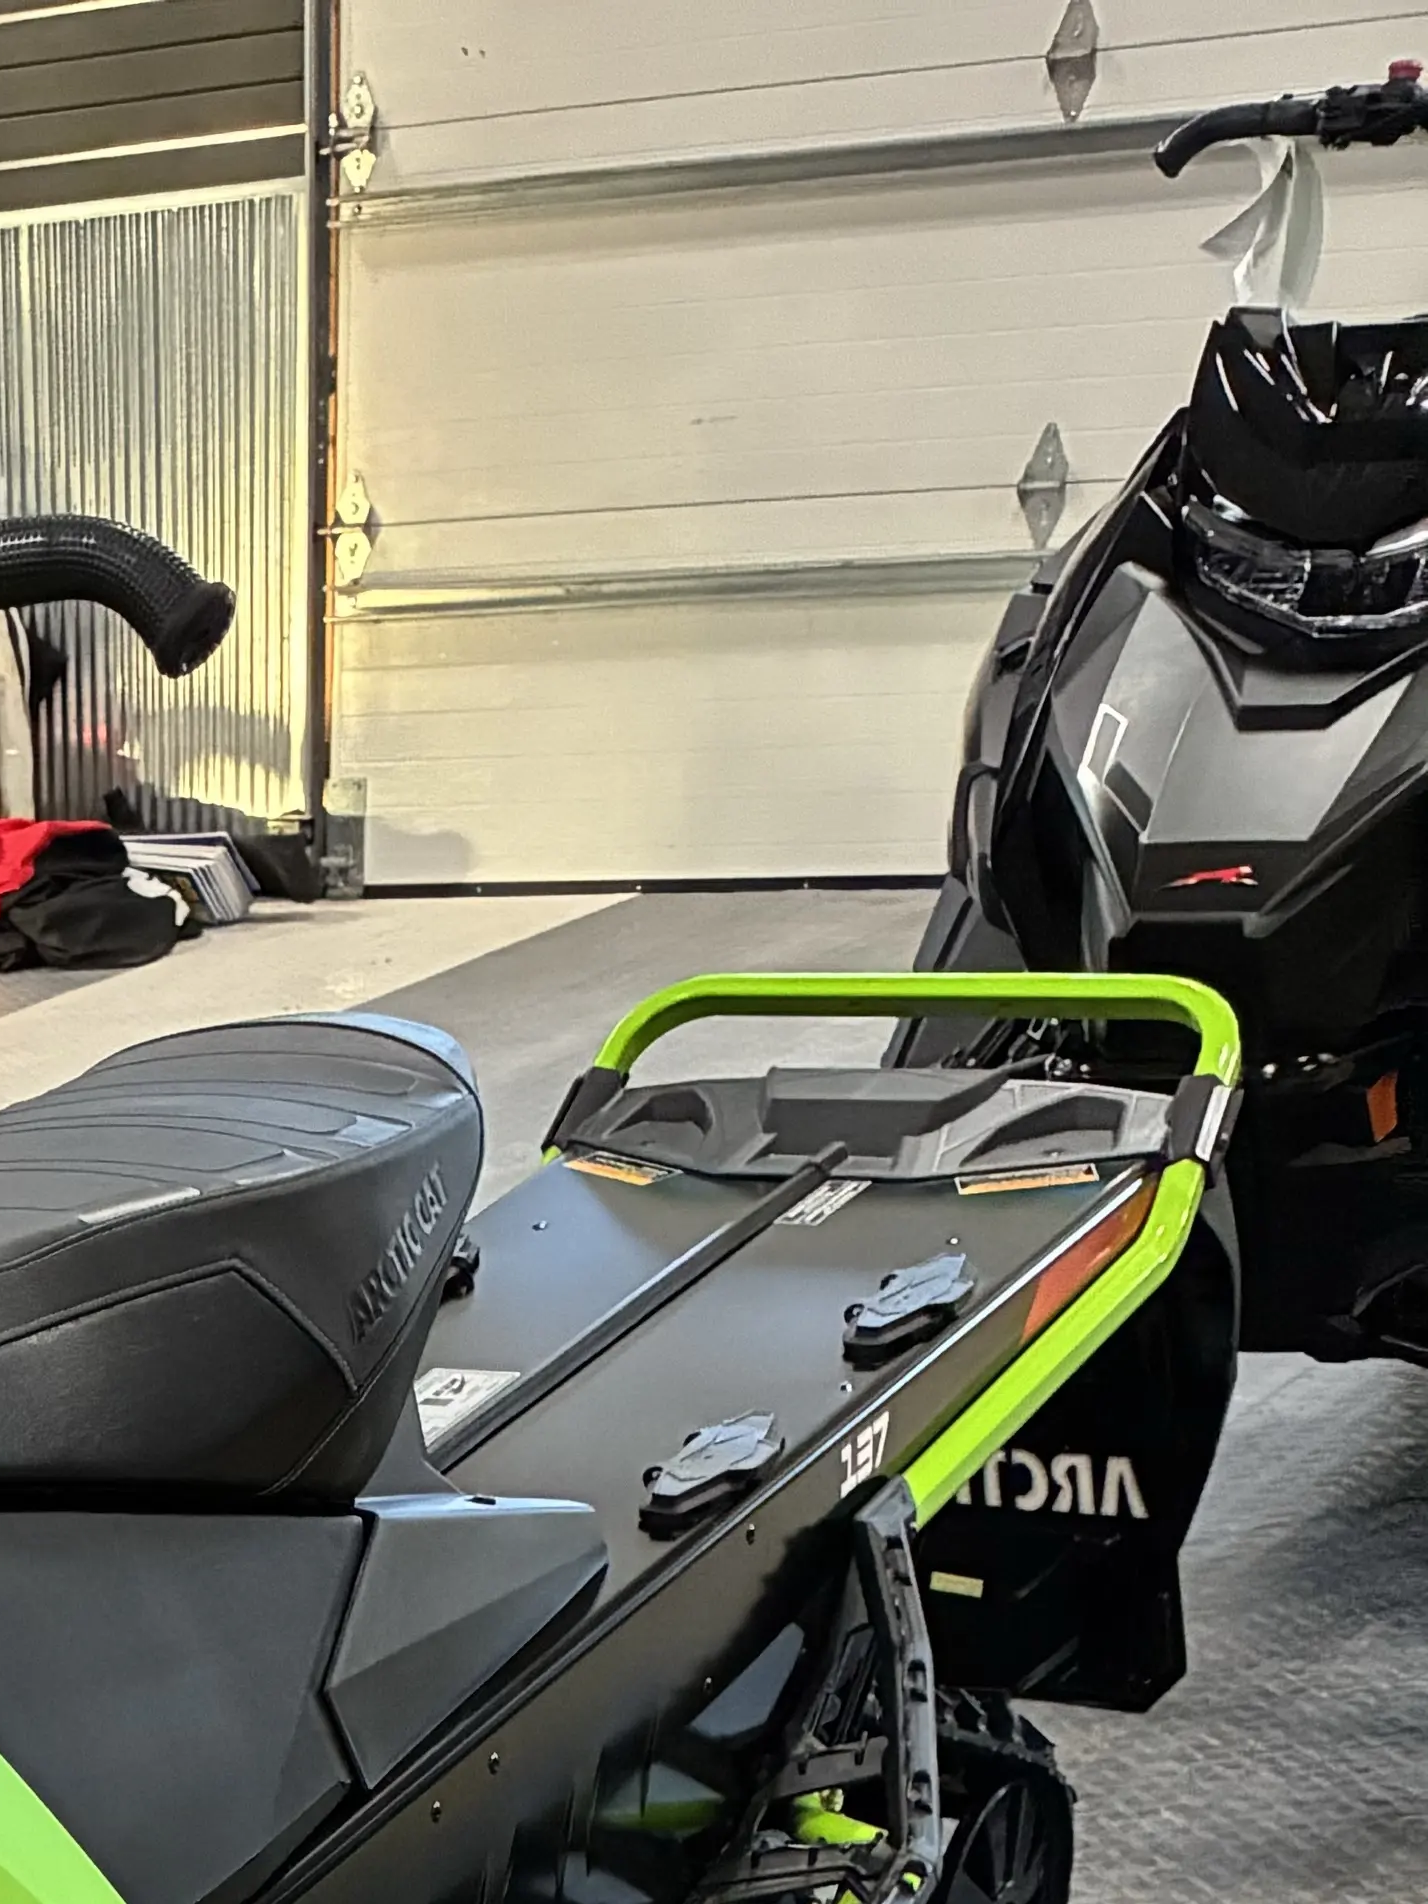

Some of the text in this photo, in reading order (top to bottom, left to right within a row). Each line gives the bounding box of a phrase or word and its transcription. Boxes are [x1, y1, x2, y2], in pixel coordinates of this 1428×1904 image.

[347, 1160, 448, 1345] ARCTIC CAT
[840, 1411, 890, 1499] 137
